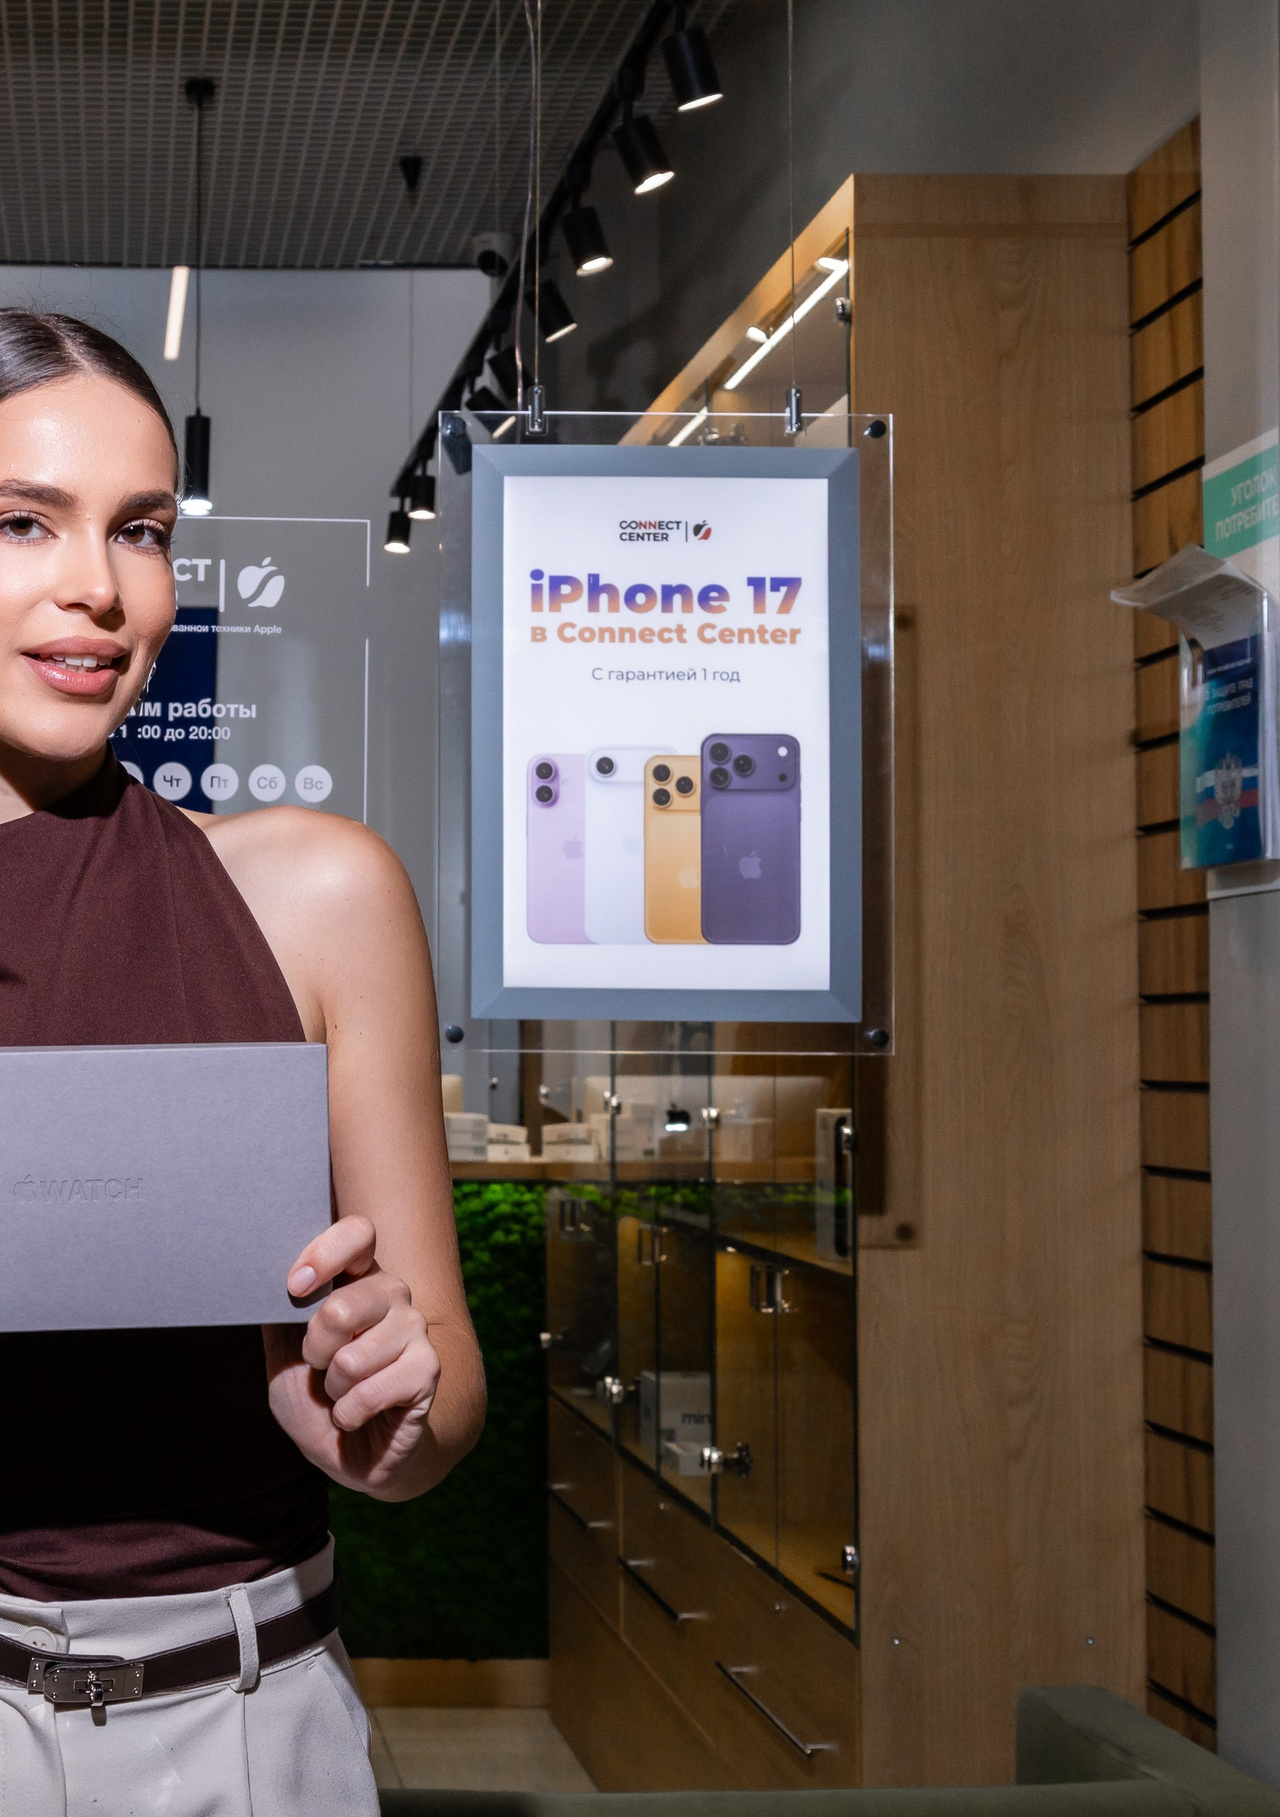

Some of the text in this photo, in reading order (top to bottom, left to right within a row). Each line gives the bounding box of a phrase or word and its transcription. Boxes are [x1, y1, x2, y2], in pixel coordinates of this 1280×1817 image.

[619, 520, 682, 531] CONNECT
[619, 532, 670, 542] CENTER
[529, 568, 803, 614] iPhone 17
[210, 624, 252, 634] техники
[253, 625, 282, 635] Apple
[556, 621, 688, 644] Connect
[696, 622, 802, 645] Center
[591, 667, 741, 684] С гарантией 1 год
[167, 697, 257, 722] работы
[163, 727, 186, 742] до
[188, 726, 231, 740] 20:00
[163, 775, 323, 790] Чт Пт Сб Вс
[39, 1177, 144, 1203] WATCH
